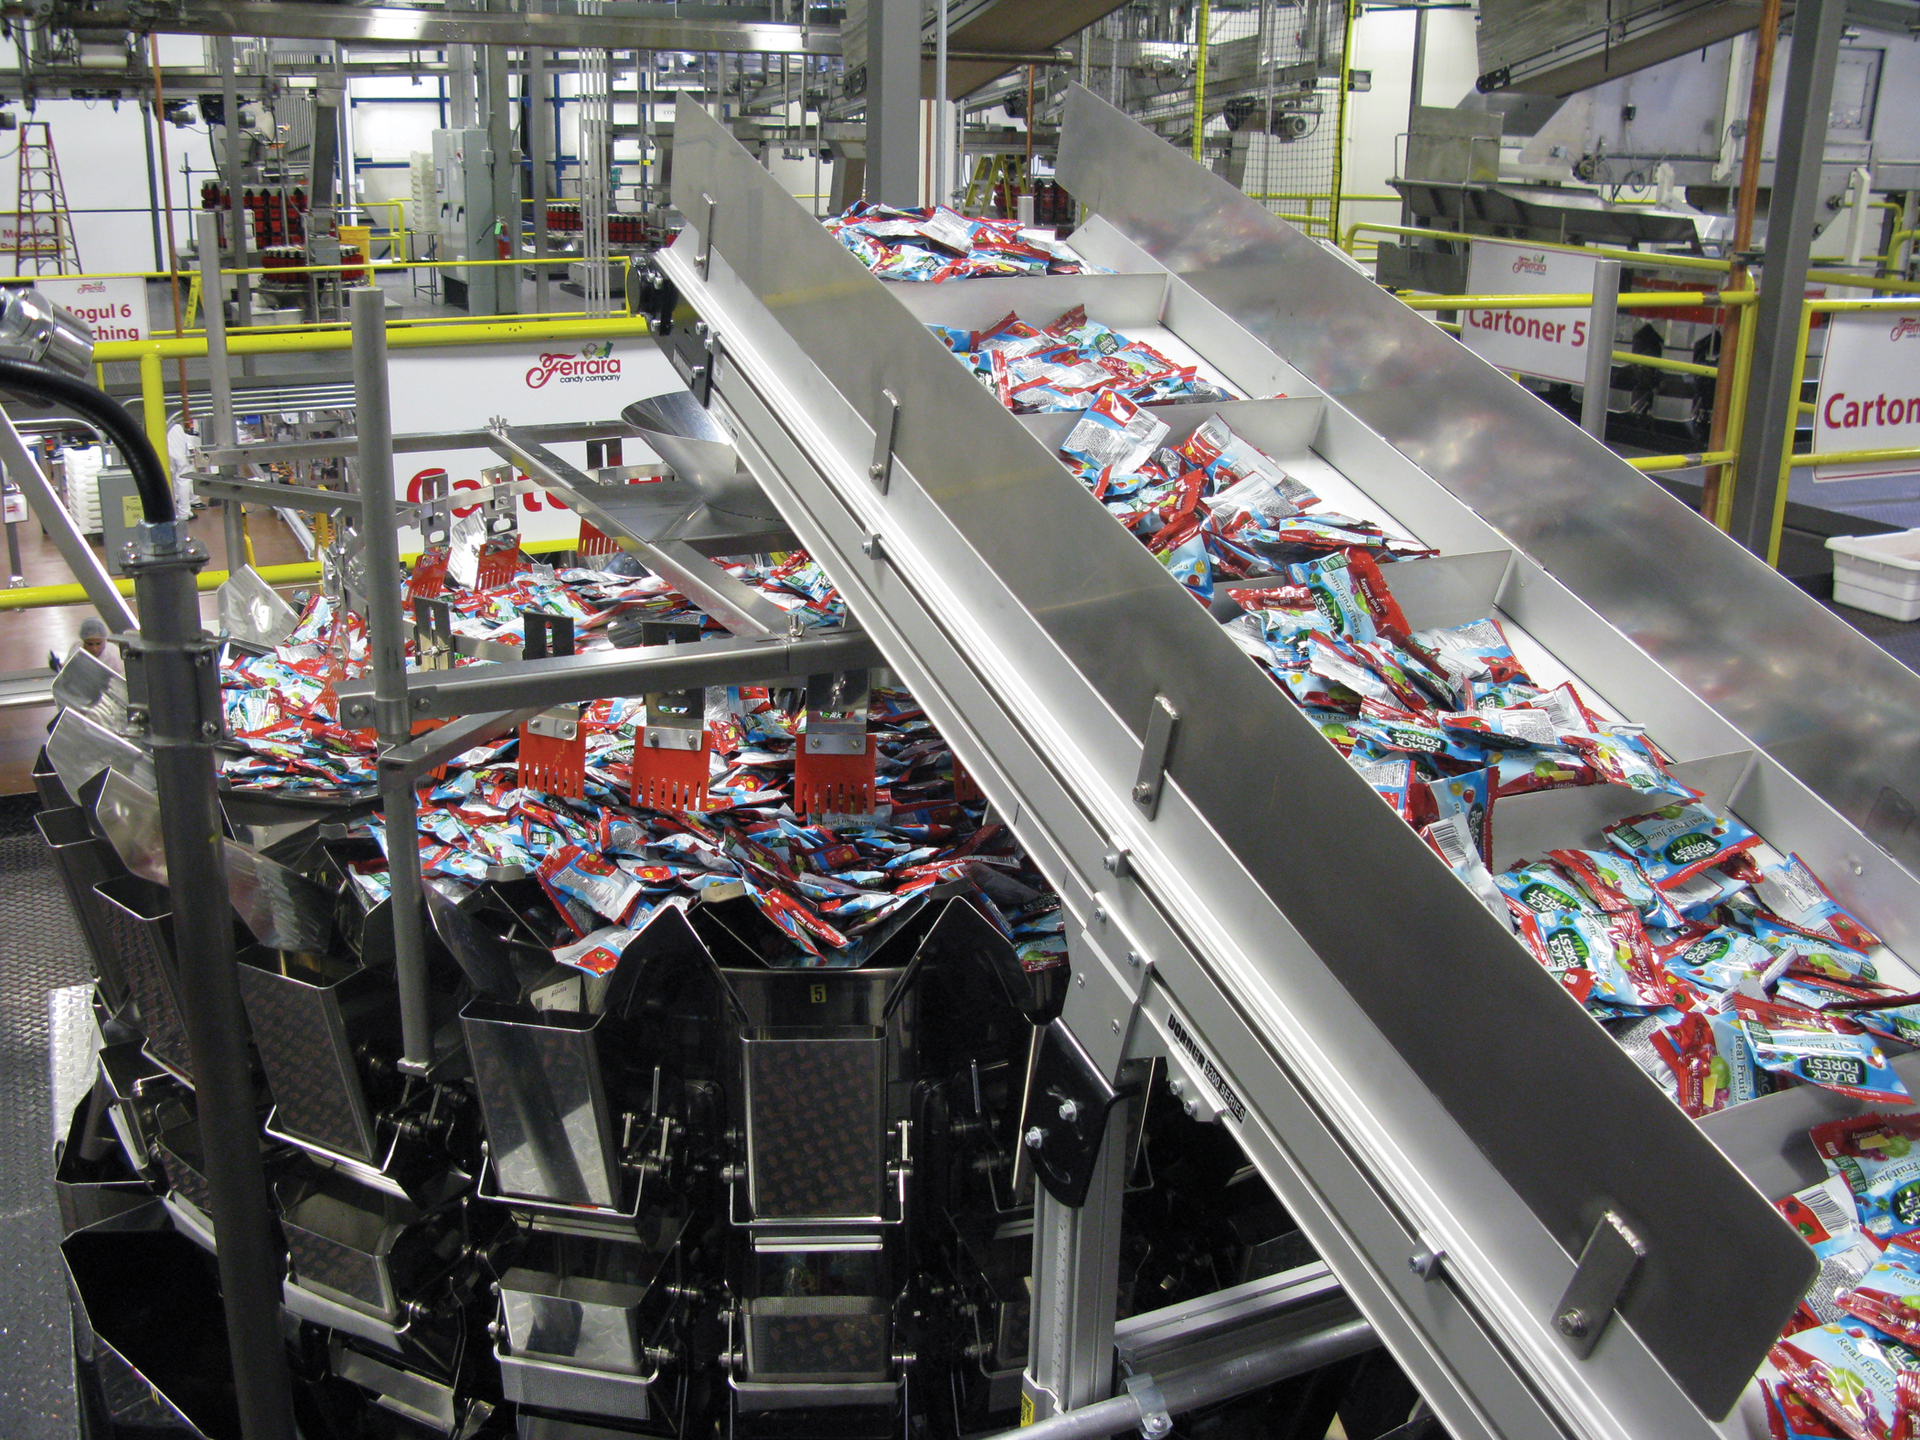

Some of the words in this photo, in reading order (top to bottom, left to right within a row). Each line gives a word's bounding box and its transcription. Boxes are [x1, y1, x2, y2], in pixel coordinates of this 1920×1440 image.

[65, 304, 116, 324] ogul
[121, 304, 132, 318] 6
[93, 325, 139, 341] ching
[1469, 309, 1566, 343] Cartoner
[1571, 321, 1586, 347] 5
[525, 353, 621, 389] Ferrara
[560, 376, 583, 384] candy
[585, 374, 621, 383] company
[1824, 392, 1920, 429] Carton
[1329, 571, 1342, 593] Juice
[1360, 578, 1373, 599] Medley
[1339, 592, 1353, 614] Fruit
[1369, 598, 1381, 613] Fruit
[1349, 613, 1361, 635] Real
[1393, 730, 1442, 750] FOREST
[1668, 821, 1690, 834] Fruit
[1690, 815, 1710, 828] Real
[1646, 828, 1668, 841] Juice
[1671, 840, 1715, 860] FOREST
[1682, 846, 1717, 862] BLACK
[1525, 896, 1549, 912] ACK
[1529, 890, 1567, 911] OREST
[1549, 938, 1568, 968] BLACK
[1558, 933, 1581, 968] FOREST
[815, 986, 822, 1001] 5
[1735, 1035, 1746, 1061] Real
[1167, 1013, 1206, 1070] DORNER
[1204, 1062, 1221, 1088] 3200
[1219, 1084, 1246, 1120] SERIES
[1806, 1058, 1859, 1073] FOREST
[1737, 1064, 1747, 1094] Fruit
[1813, 1069, 1858, 1084] BLACK
[1692, 1078, 1701, 1107] Medley
[1892, 1161, 1920, 1178] Fruit
[1867, 1174, 1893, 1189] Juice
[1837, 1337, 1862, 1367] Real
[1861, 1358, 1894, 1390] Fruit
